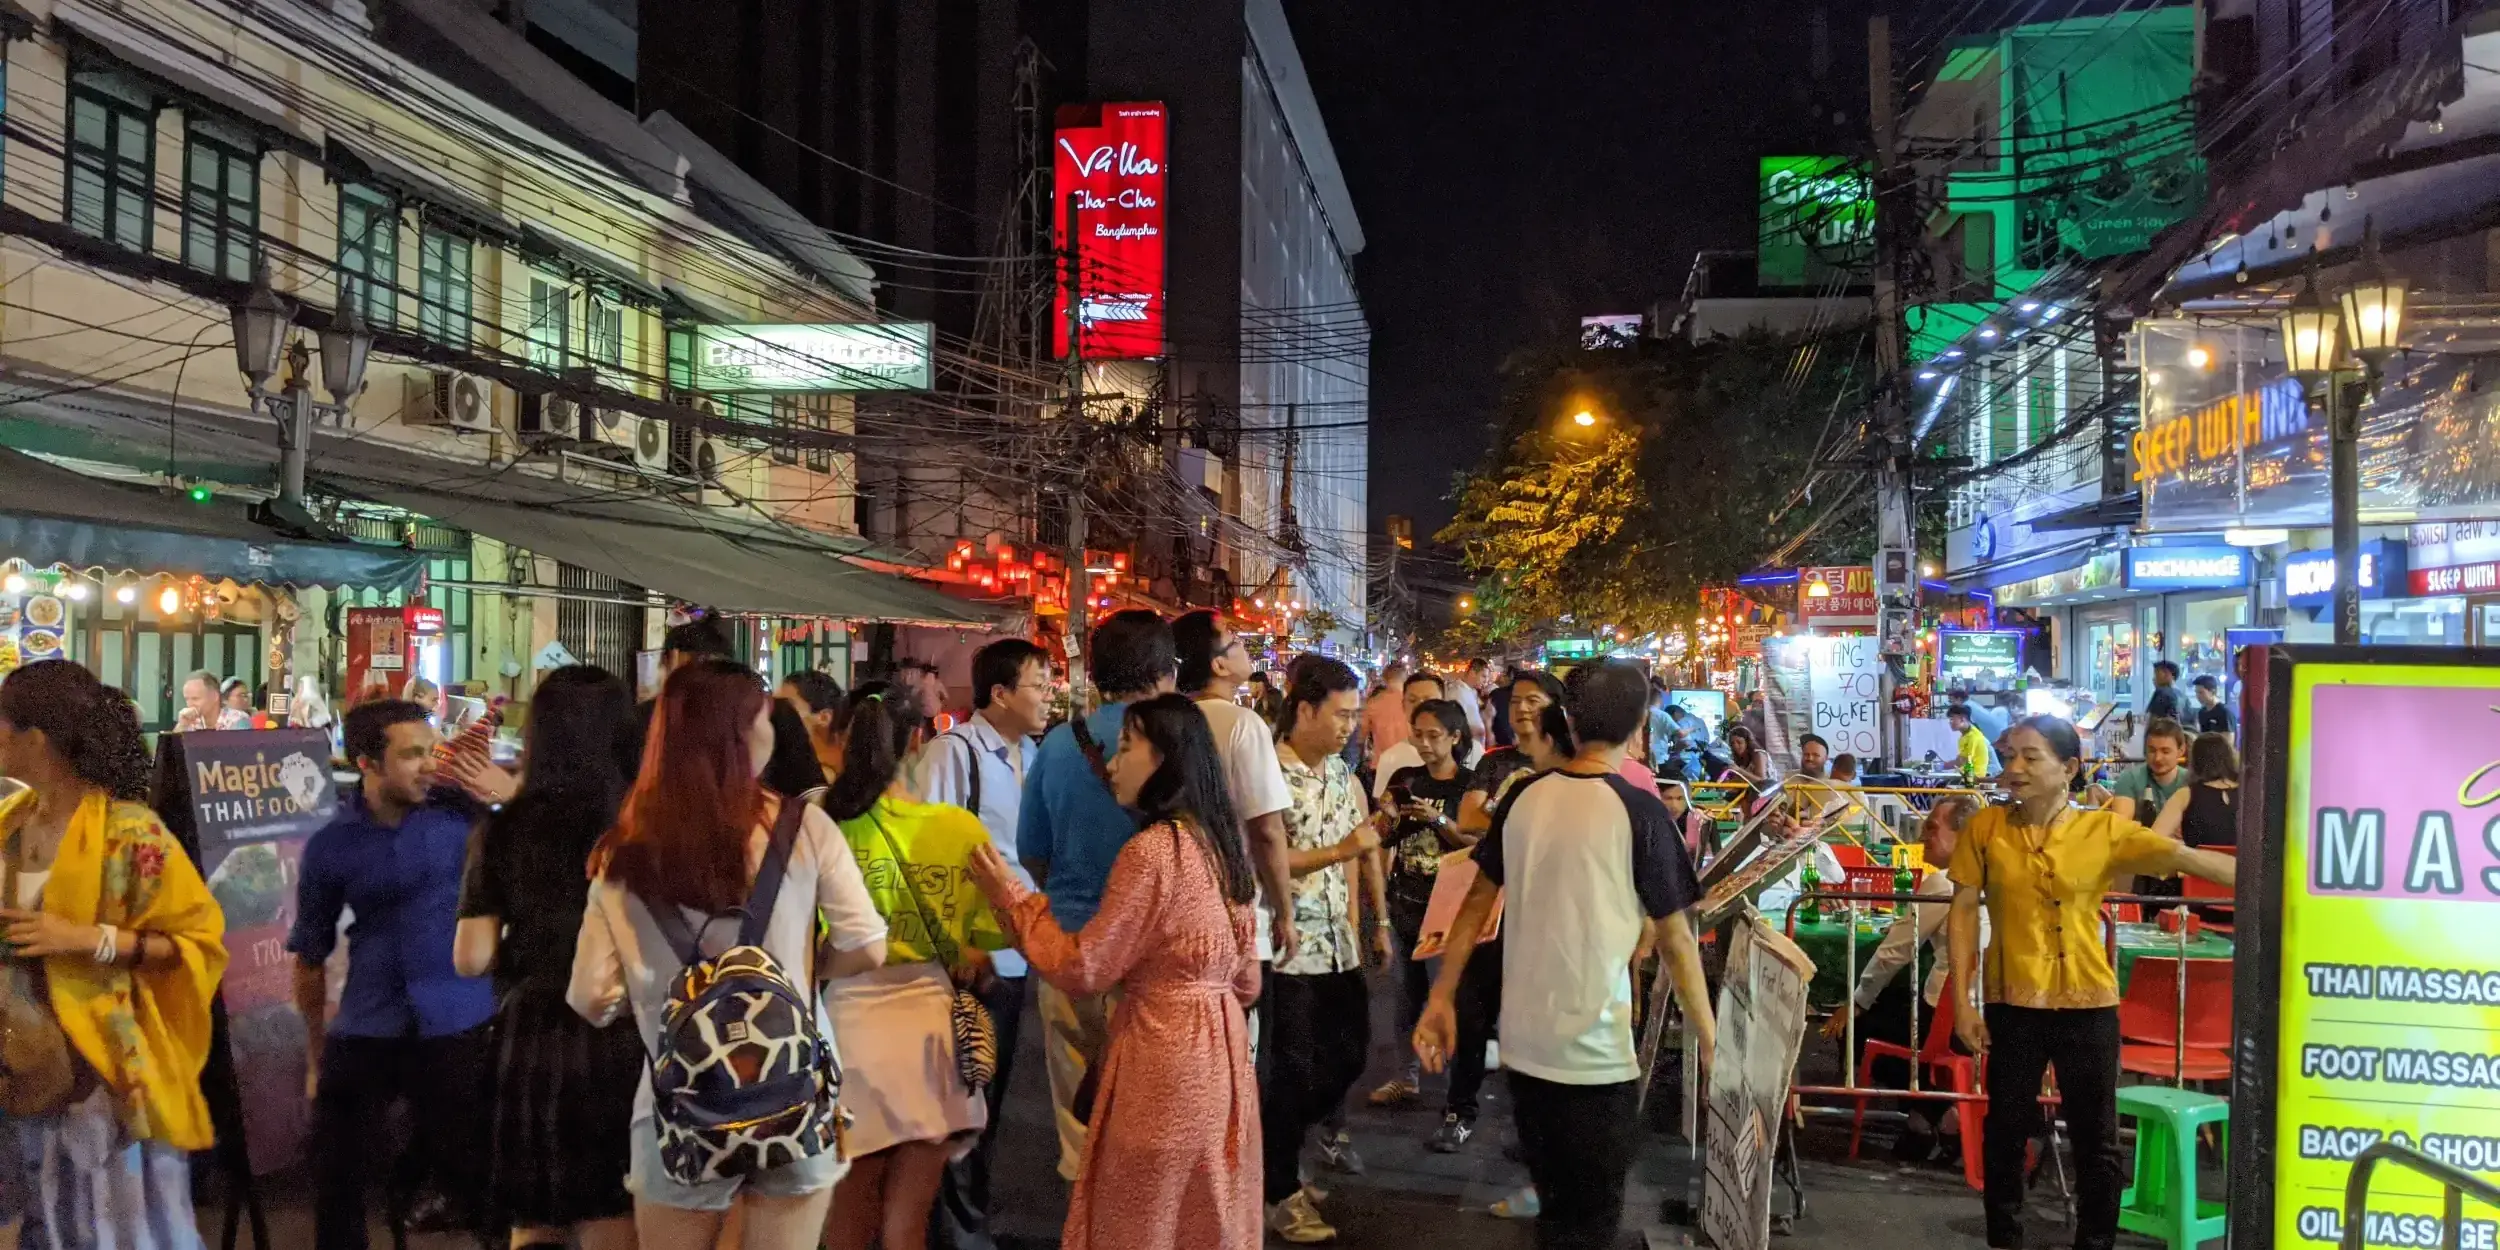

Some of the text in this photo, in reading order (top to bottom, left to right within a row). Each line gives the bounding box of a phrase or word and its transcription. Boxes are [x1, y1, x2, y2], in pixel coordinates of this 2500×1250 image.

[1059, 138, 1159, 178] Villa
[1095, 222, 1158, 241] Banglumphu
[2133, 415, 2192, 482] SLEEP
[2134, 558, 2240, 577] EXCHANGE
[2285, 553, 2373, 596] EXCHAE
[2427, 568, 2461, 592] SLEEP
[1837, 672, 1876, 698] 70
[1816, 700, 1879, 728] BUCKET
[1833, 730, 1875, 753] 90
[196, 752, 283, 798] Magic
[200, 797, 303, 823] THAIFOO
[2306, 965, 2372, 997] THAI
[2303, 1046, 2379, 1079] FOOT
[2301, 1127, 2382, 1159] BACK
[2299, 1209, 2496, 1250] OIL MASSGE
